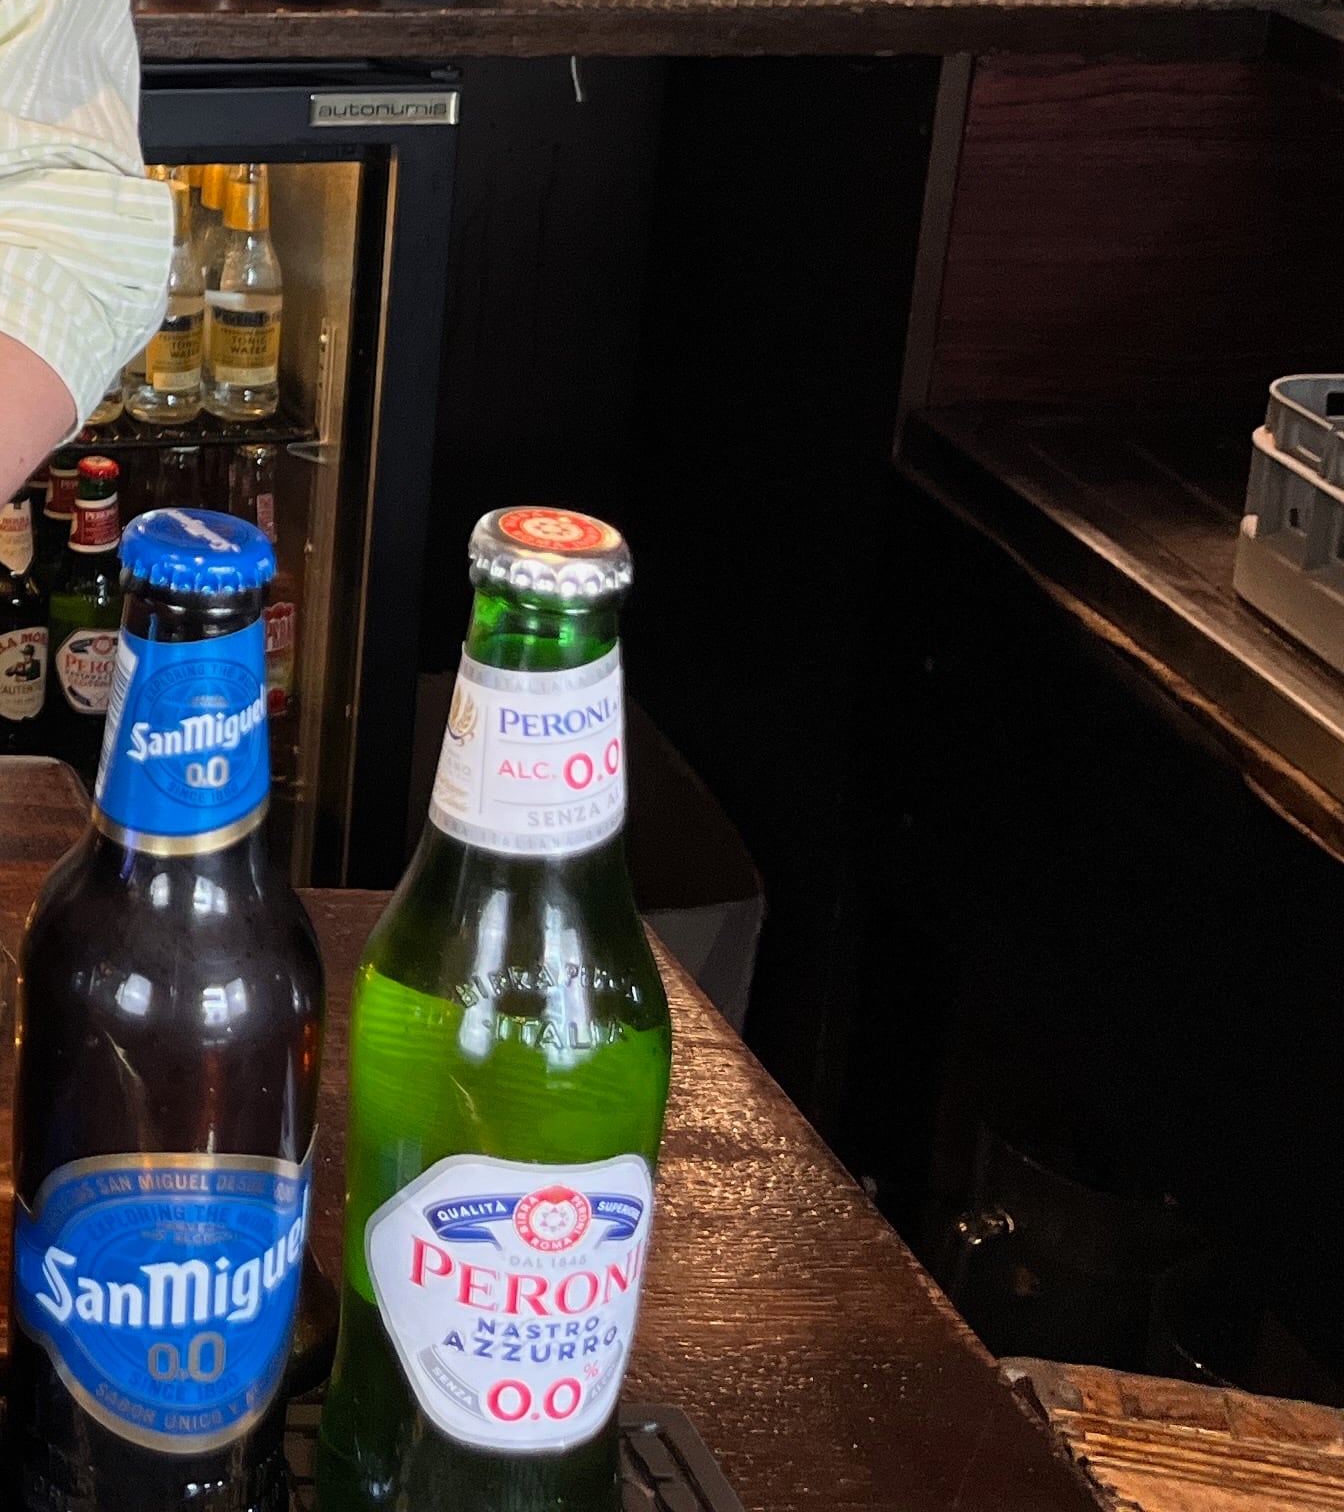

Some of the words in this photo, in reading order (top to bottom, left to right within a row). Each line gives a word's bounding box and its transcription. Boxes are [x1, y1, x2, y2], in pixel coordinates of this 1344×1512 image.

[499, 696, 611, 738] PERONI
[527, 801, 601, 827] SENZA
[137, 1173, 209, 1192] MIGUEL
[87, 1202, 182, 1241] EXPLORING
[436, 1200, 507, 1222] QUALITÀ
[517, 1196, 540, 1234] BIRRA
[529, 1235, 572, 1250] ROMA
[477, 1316, 599, 1338] NASTRO
[442, 1325, 618, 1363] AZZURRO
[431, 1366, 474, 1407] SENZA
